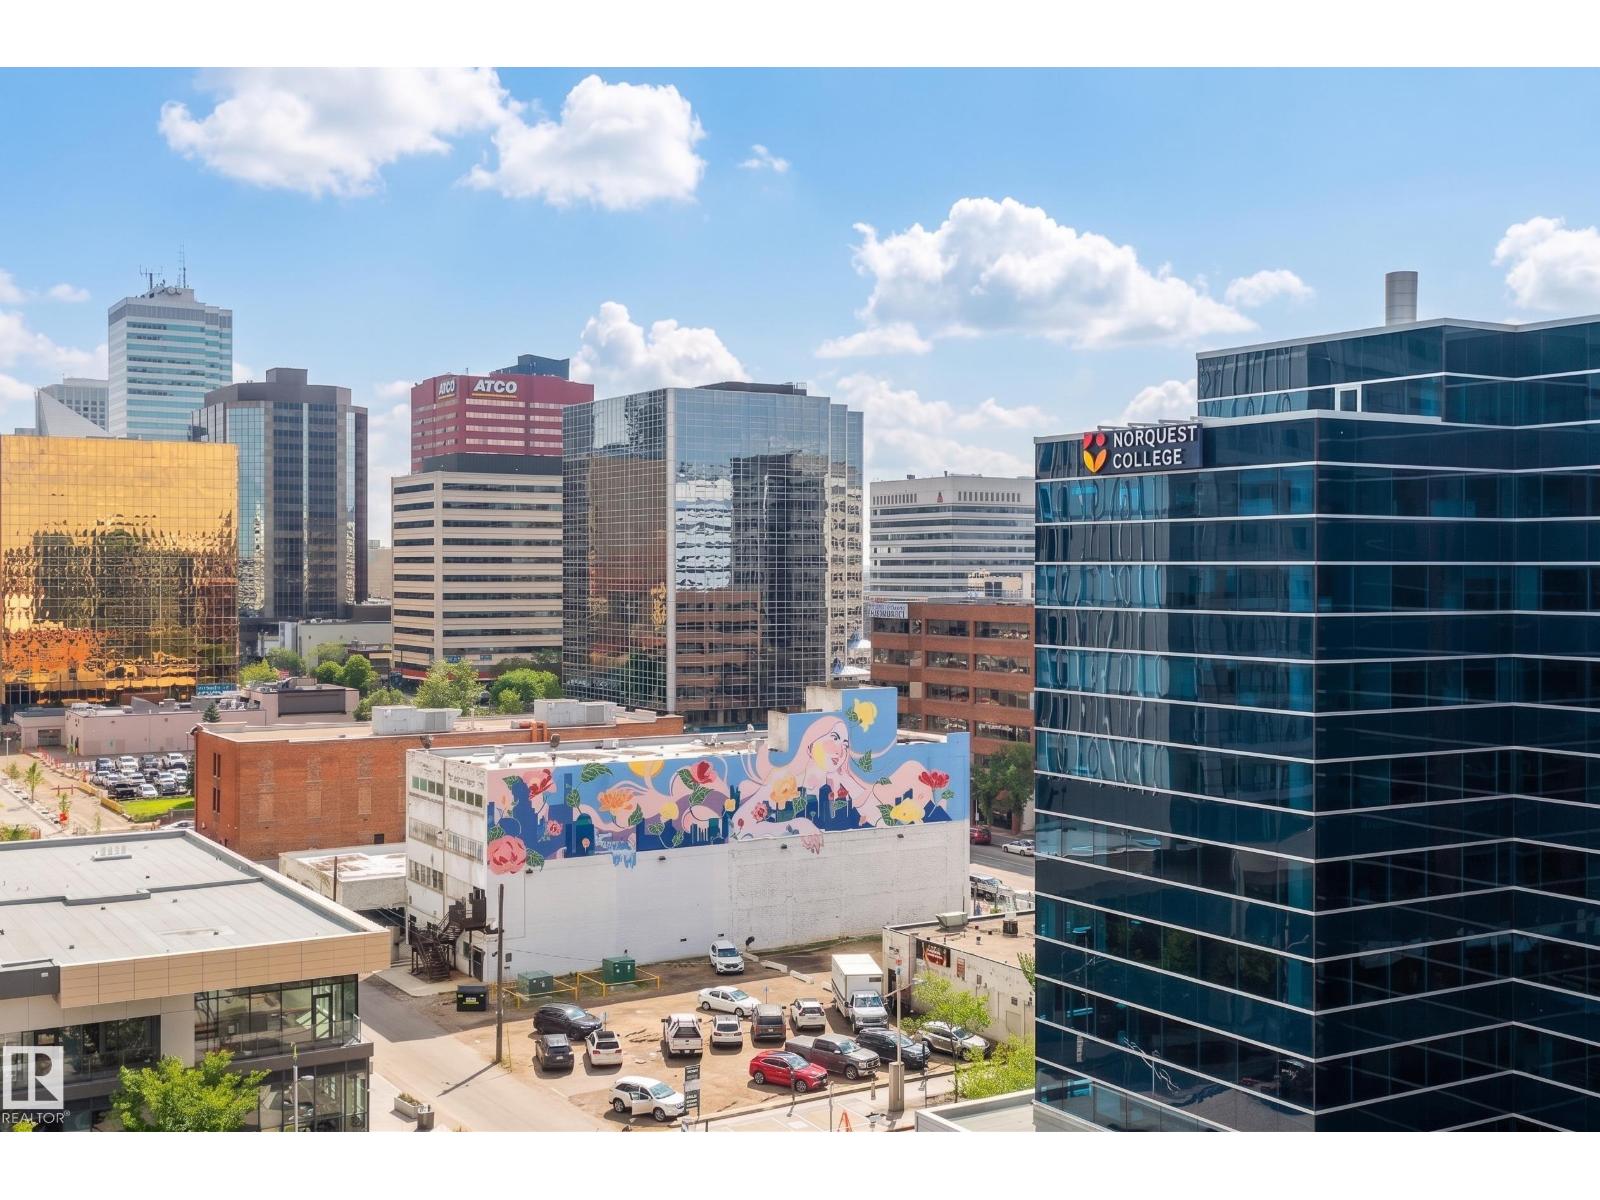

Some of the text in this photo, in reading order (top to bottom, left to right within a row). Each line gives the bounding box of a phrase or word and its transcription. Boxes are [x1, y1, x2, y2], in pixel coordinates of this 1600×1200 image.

[438, 380, 455, 396] ATCO
[473, 379, 518, 394] ATCO
[1113, 425, 1198, 448] NORQUEST
[1112, 448, 1183, 469] COLLEGE
